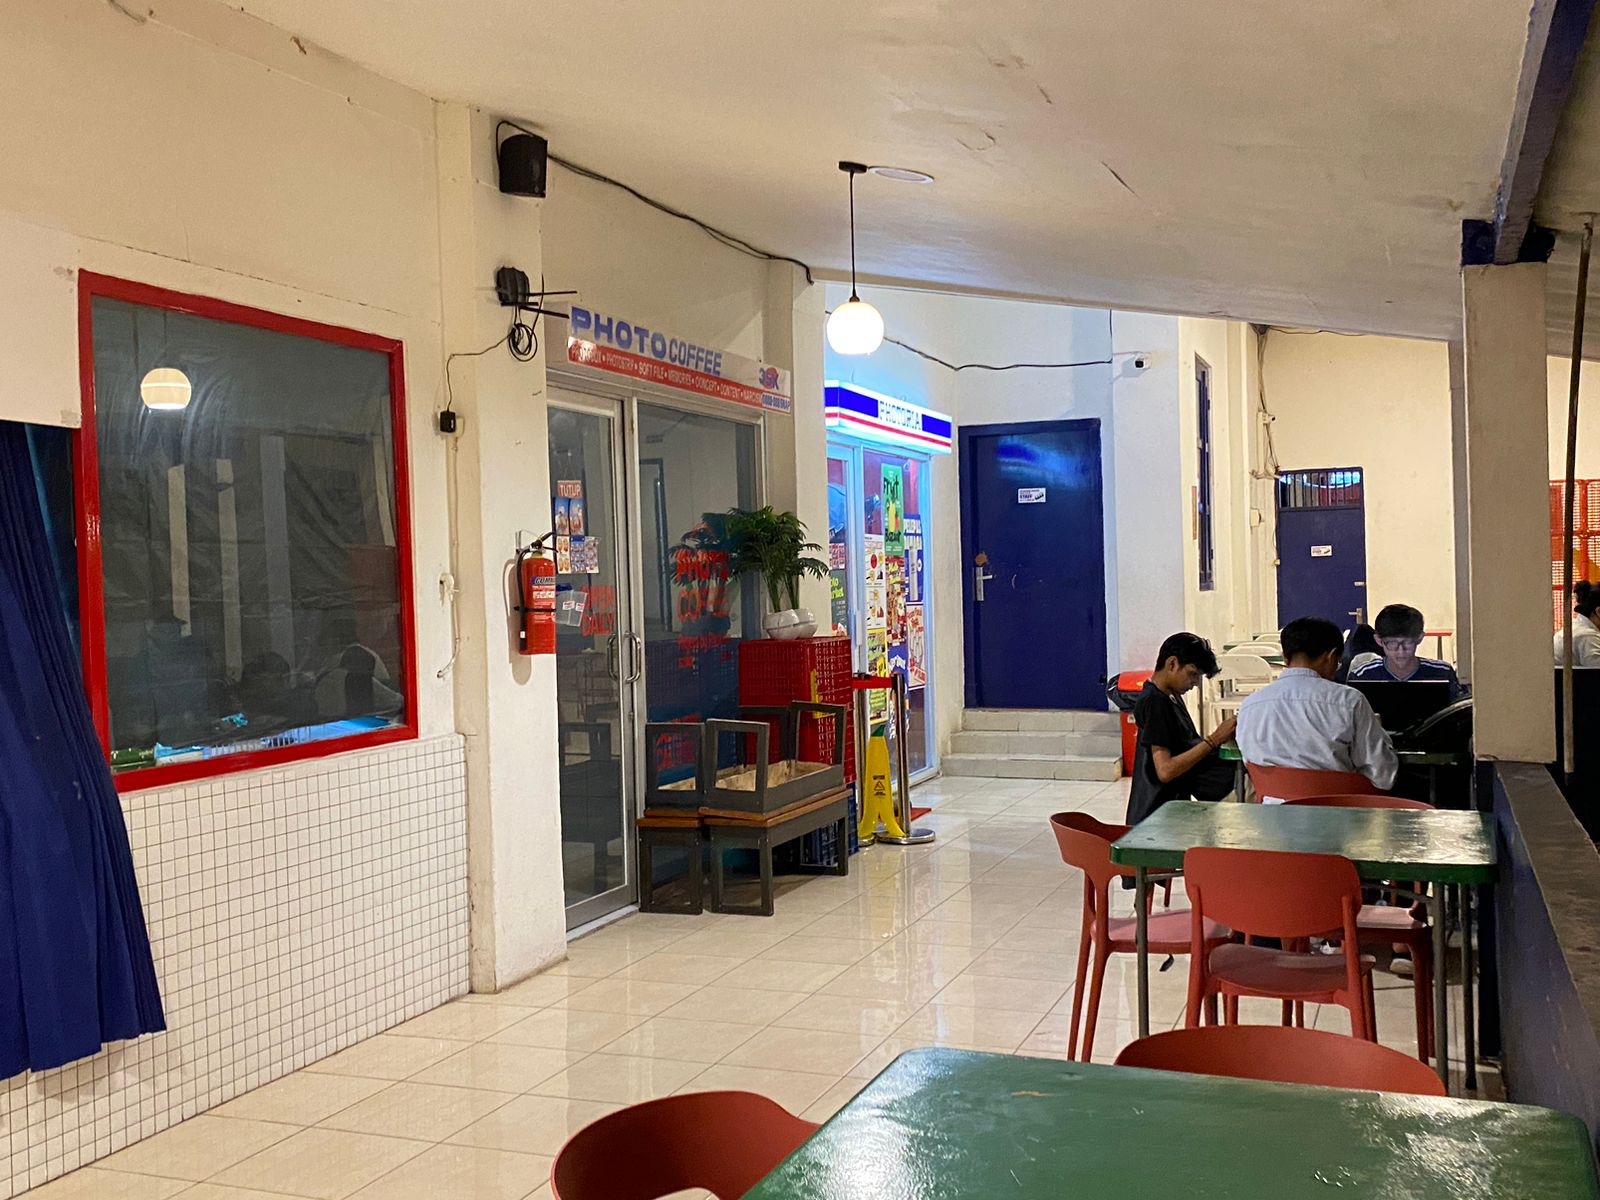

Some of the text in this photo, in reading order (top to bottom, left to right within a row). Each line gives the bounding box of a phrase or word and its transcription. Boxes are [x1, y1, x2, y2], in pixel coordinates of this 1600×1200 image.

[571, 306, 722, 377] PHOTO COFFEE
[559, 484, 581, 497] TUTUP
[582, 585, 613, 611] OPEN
[581, 612, 614, 637] DAILY
